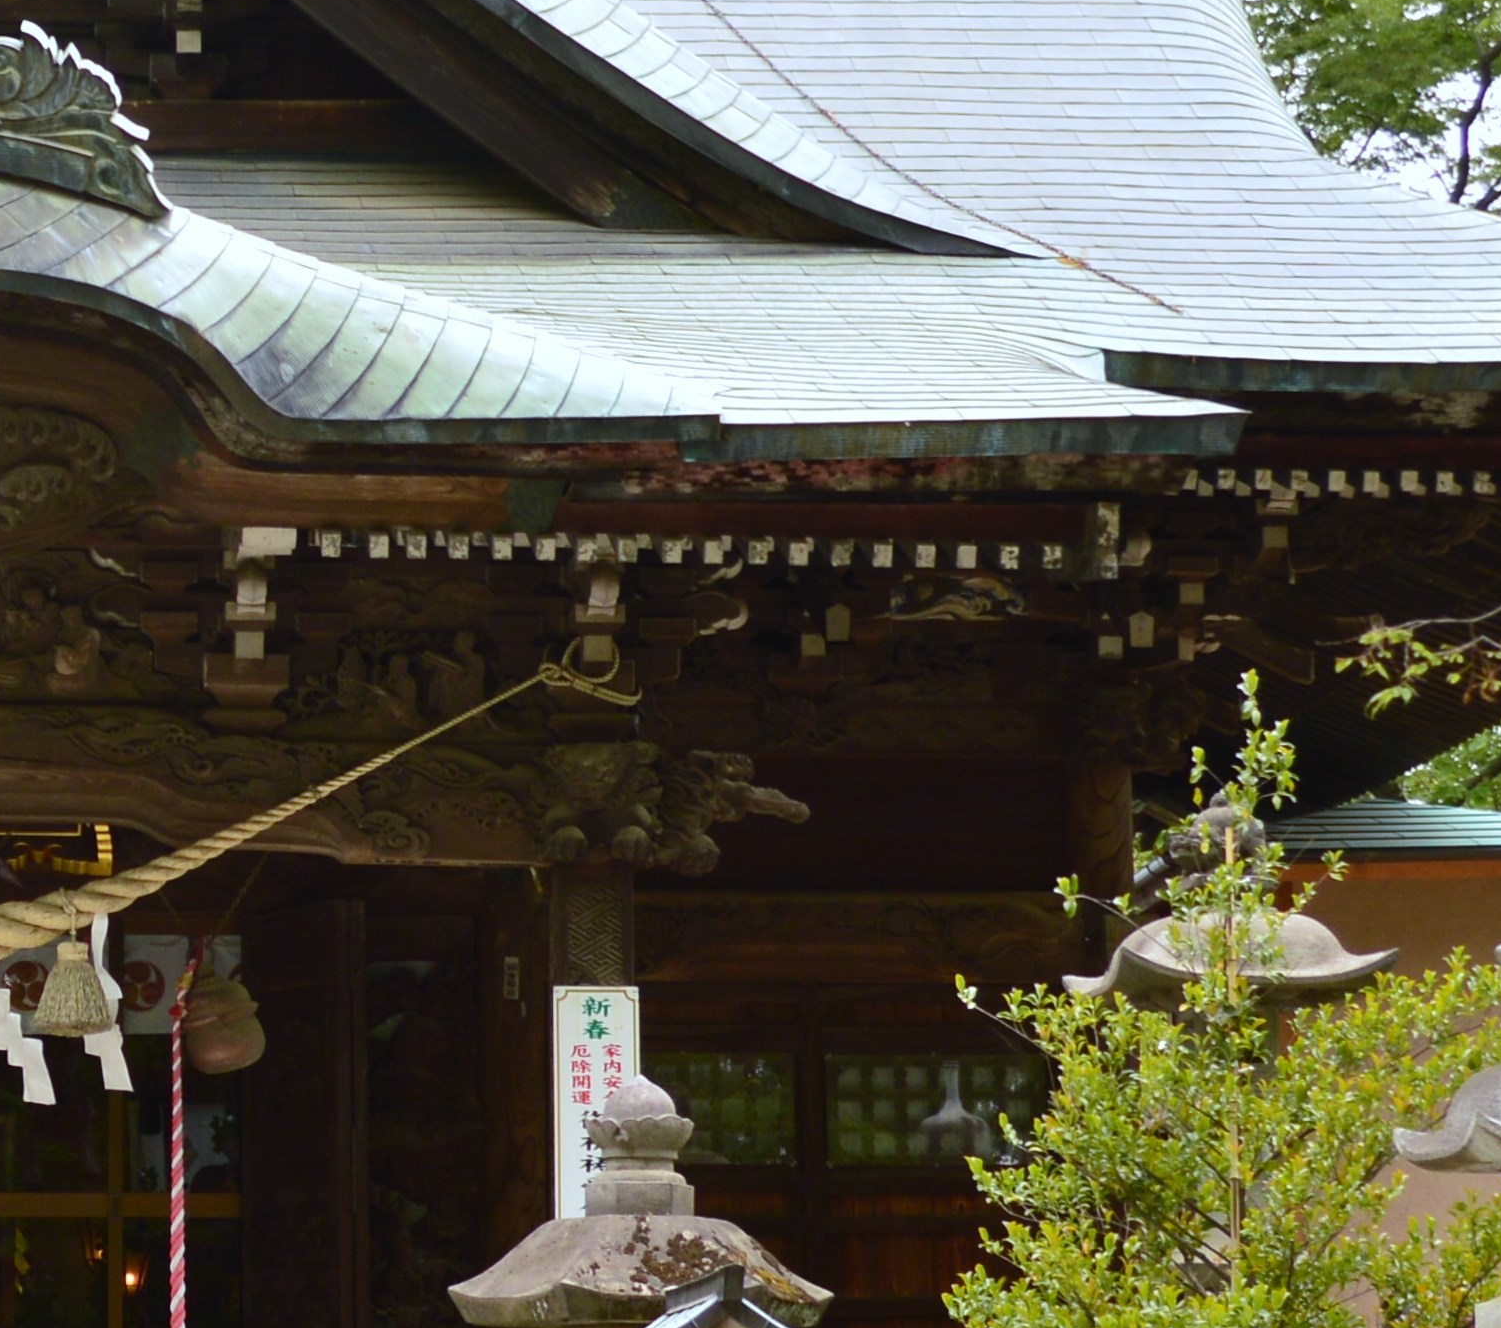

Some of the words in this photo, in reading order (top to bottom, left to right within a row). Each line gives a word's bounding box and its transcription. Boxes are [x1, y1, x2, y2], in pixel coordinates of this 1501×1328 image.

[581, 996, 613, 1040] 新春
[570, 1044, 594, 1106] 厄除開運
[601, 1043, 623, 1099] 家内安
